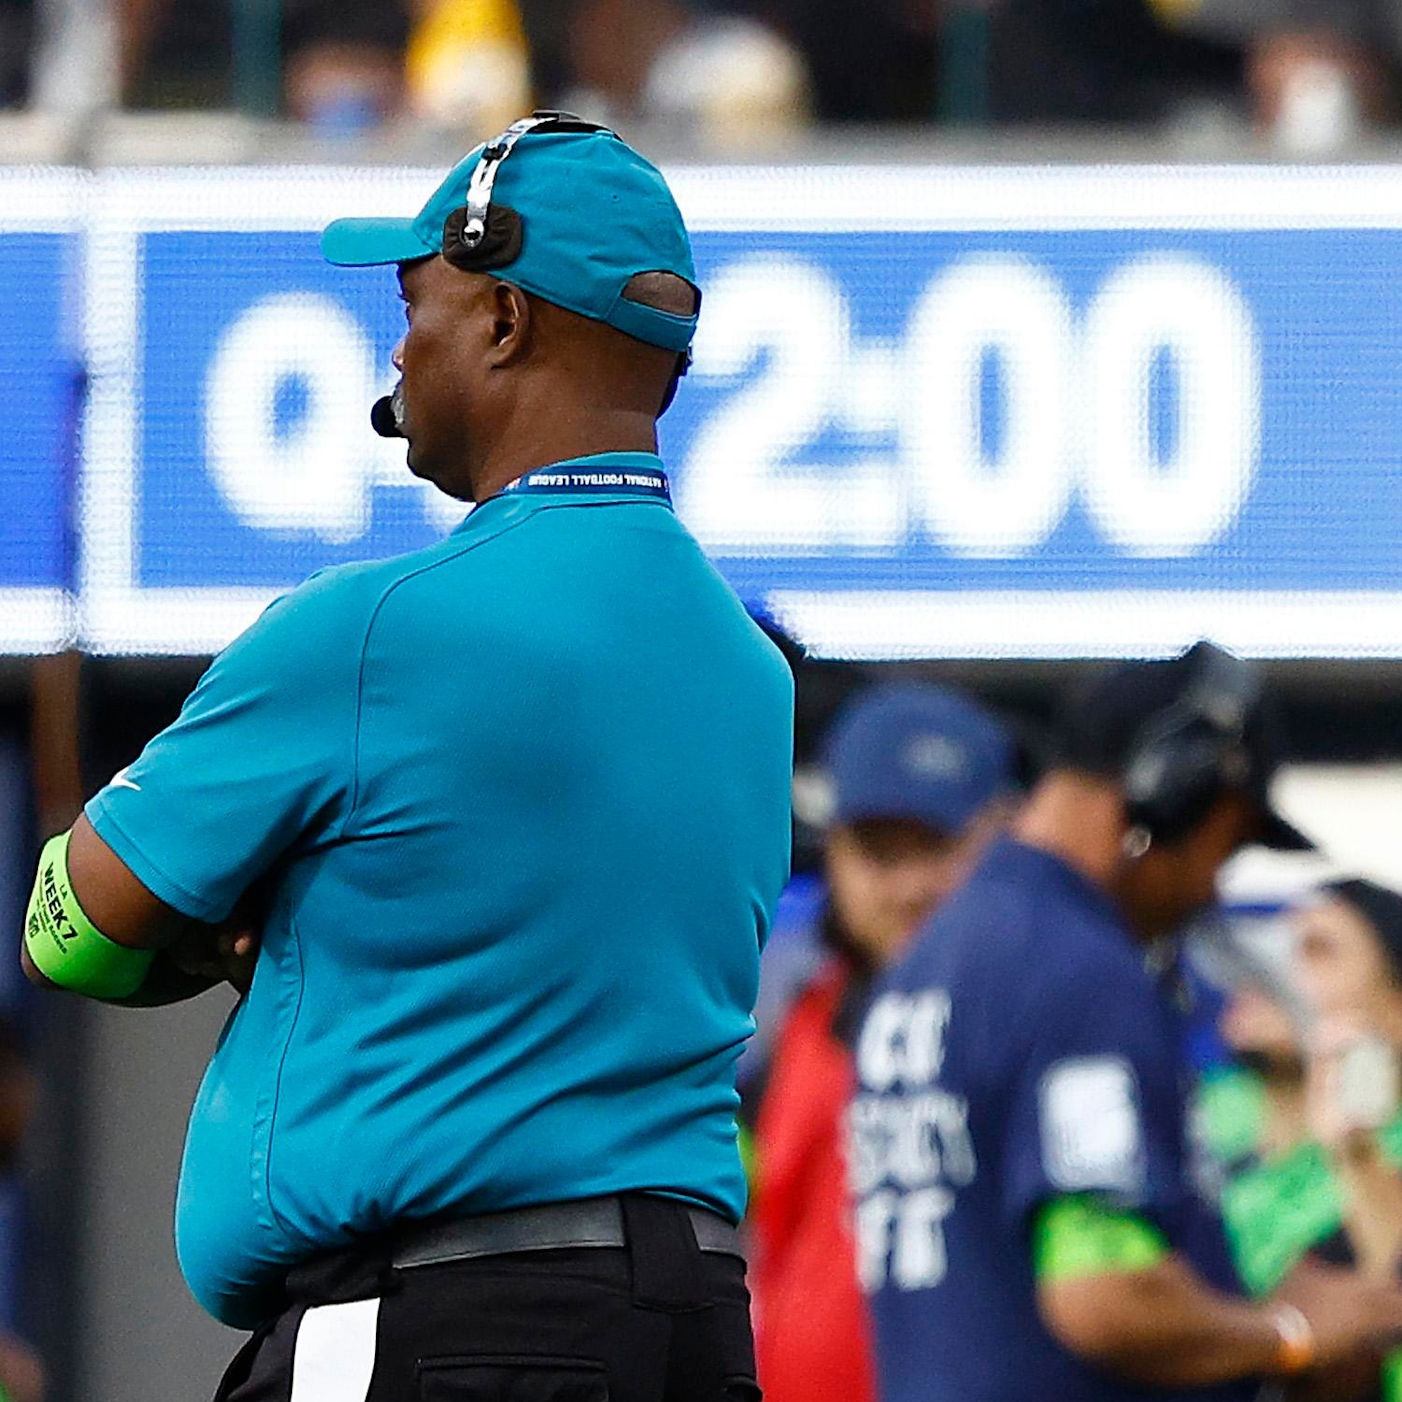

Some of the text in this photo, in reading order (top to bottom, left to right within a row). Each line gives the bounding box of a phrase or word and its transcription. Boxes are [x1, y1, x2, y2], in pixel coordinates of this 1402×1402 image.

[528, 474, 570, 486] LEAGUE
[571, 474, 624, 487] FOOTBALL
[44, 861, 68, 930] WEEK
[62, 924, 79, 940] 7
